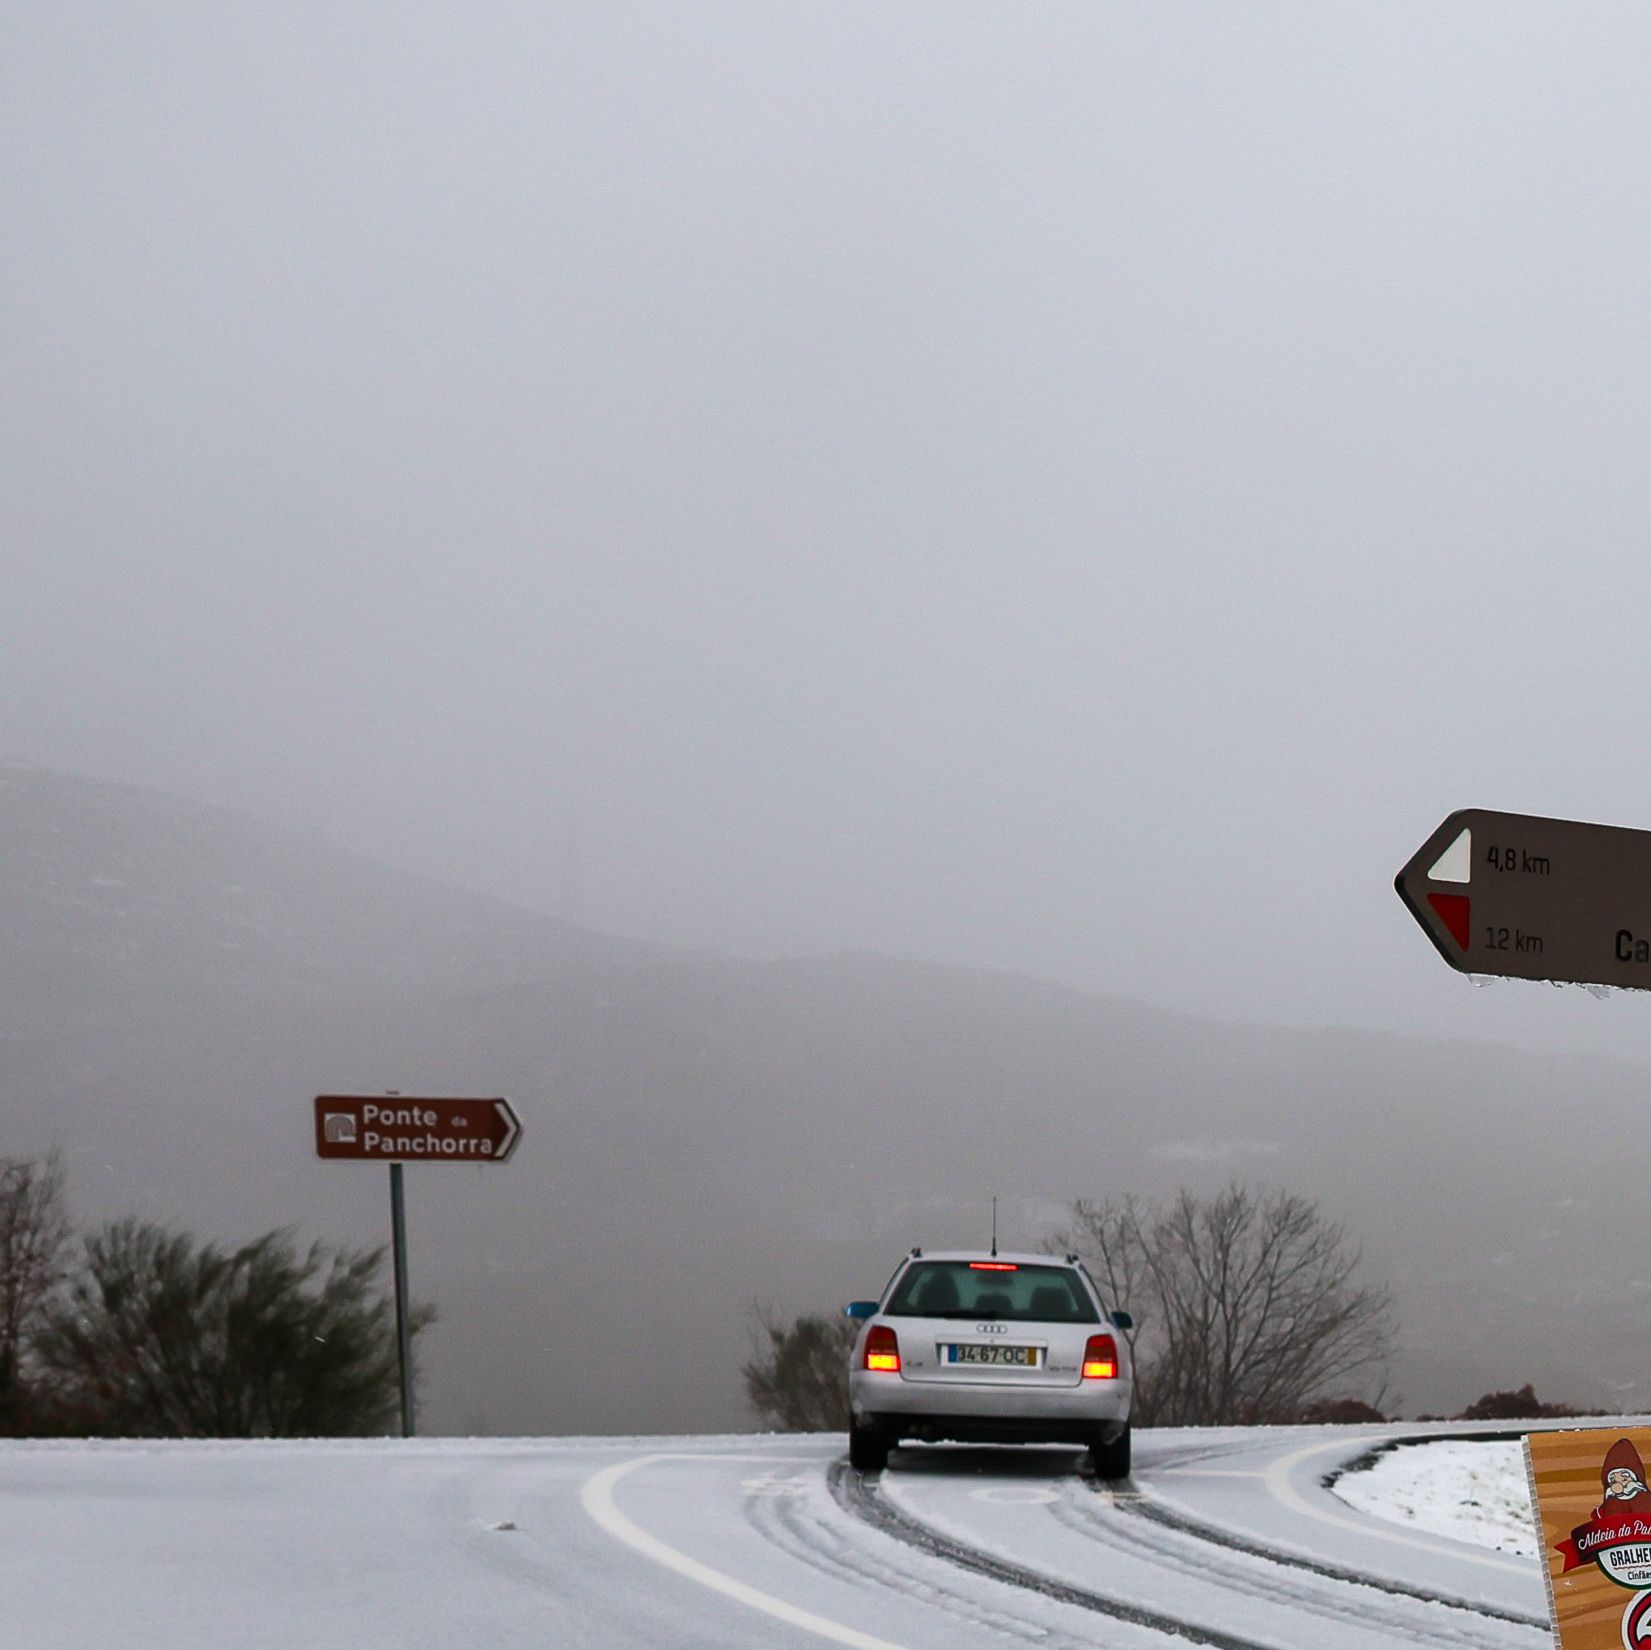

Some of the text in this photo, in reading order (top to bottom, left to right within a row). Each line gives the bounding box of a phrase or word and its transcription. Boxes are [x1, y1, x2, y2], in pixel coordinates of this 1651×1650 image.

[1486, 845, 1551, 875] 4,8 km
[1484, 926, 1544, 954] 12 km
[362, 1104, 468, 1127] Ponte da
[363, 1131, 493, 1154] Panchorra
[1578, 1527, 1617, 1550] Aldeia
[1618, 1524, 1632, 1538] do
